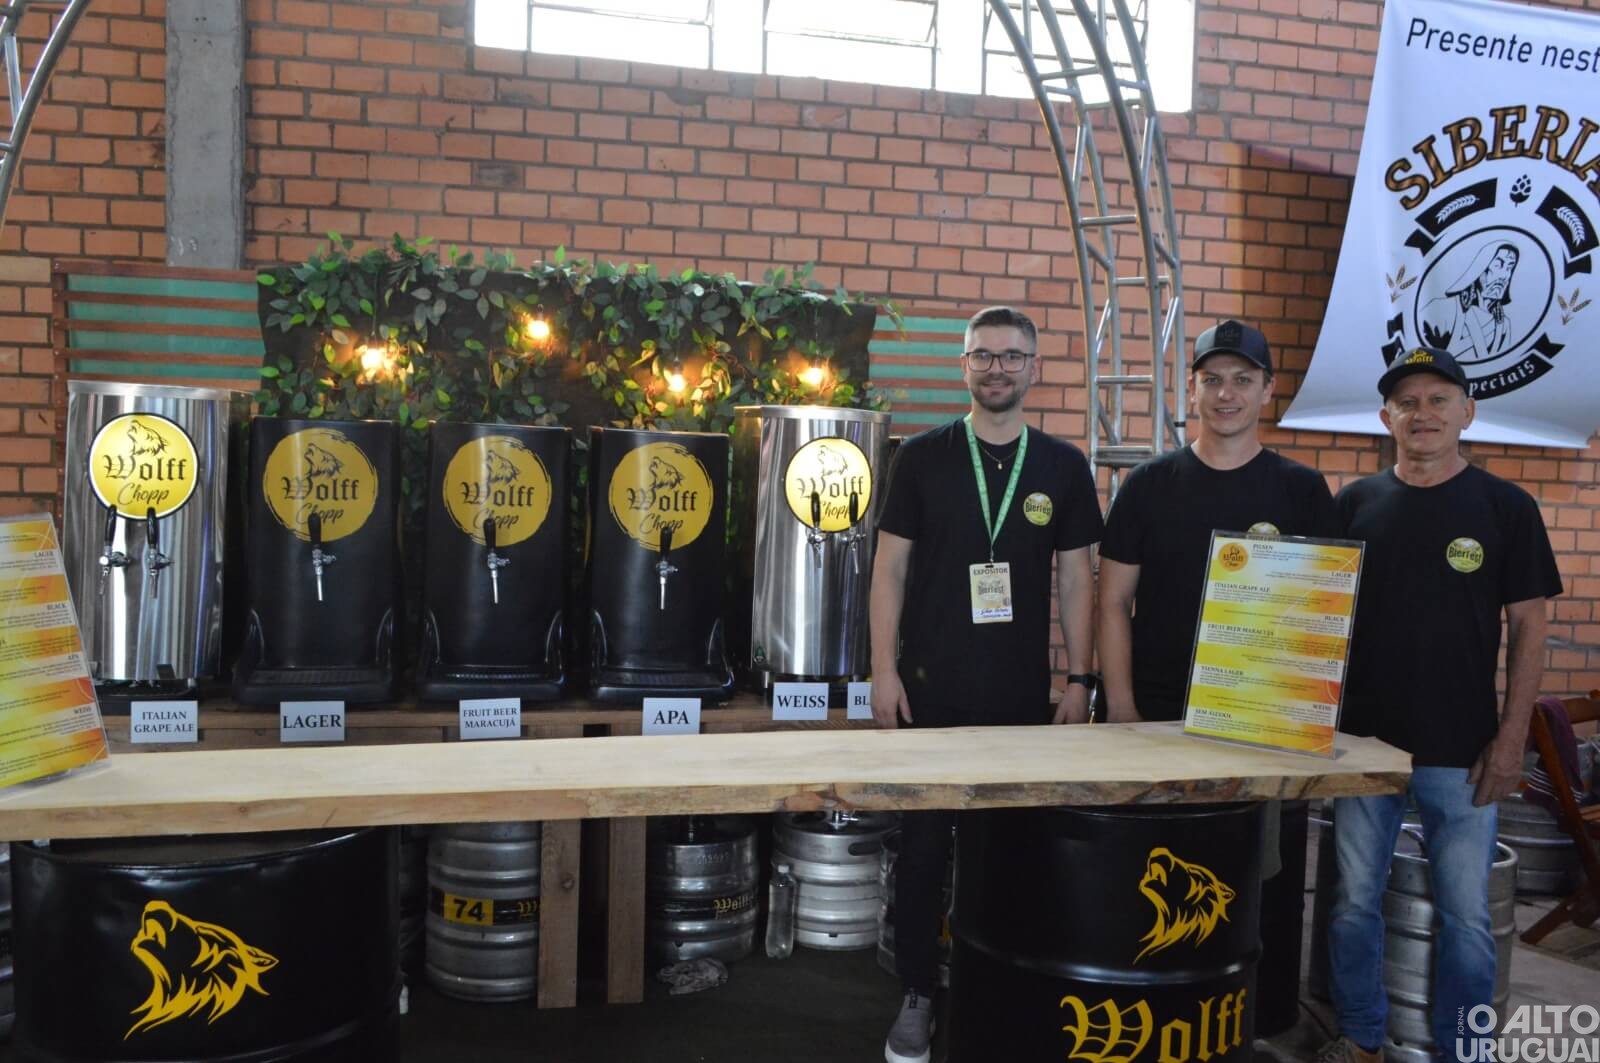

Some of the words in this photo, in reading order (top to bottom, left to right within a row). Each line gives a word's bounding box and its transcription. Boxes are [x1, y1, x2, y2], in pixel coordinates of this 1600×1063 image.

[1406, 18, 1533, 63] Presente
[103, 454, 188, 481] Wolff
[117, 482, 169, 505] Chopp
[281, 476, 360, 501] Wolff
[461, 481, 535, 508] Wolff
[797, 476, 864, 499] Wolff
[627, 488, 698, 512] Wolff
[473, 508, 520, 529] Copp
[463, 708, 491, 718] FRUIT
[493, 707, 518, 716] BEER
[776, 695, 827, 708] WEISS
[142, 711, 188, 721] ITALIAN
[282, 714, 343, 729] LAGER
[464, 718, 516, 728] MARACUJÁ
[653, 710, 690, 725] APA
[133, 724, 172, 734] GRAPE
[174, 724, 195, 733] ALE
[453, 899, 485, 922] 74
[1060, 988, 1247, 1063] Wolff
